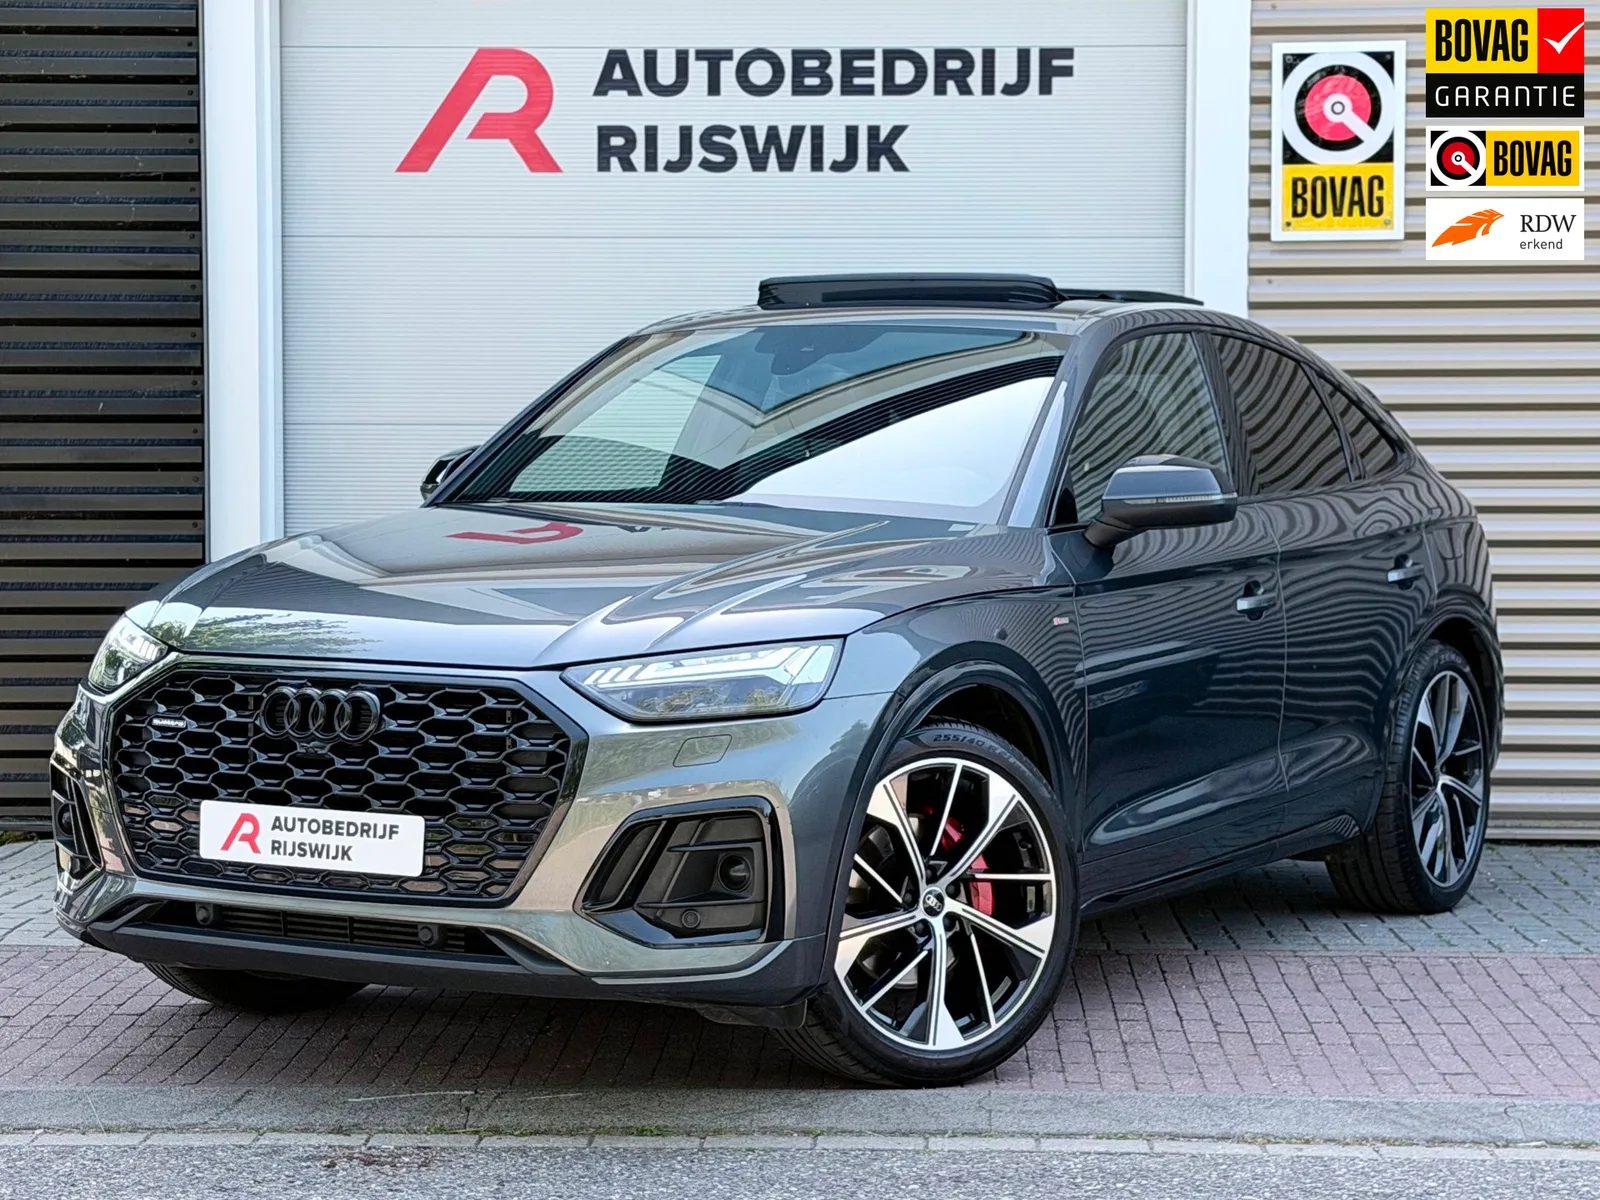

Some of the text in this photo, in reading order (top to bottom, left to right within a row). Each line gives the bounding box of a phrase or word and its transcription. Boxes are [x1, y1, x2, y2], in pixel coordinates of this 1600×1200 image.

[592, 47, 1075, 97] AUTOBEDRIJF
[596, 124, 910, 173] RIJSWIJK
[1290, 174, 1385, 219] BOVAG
[933, 734, 985, 747] 255/40
[271, 815, 400, 840] AUTOBEDRIJF
[271, 839, 353, 862] RIJSWIJK
